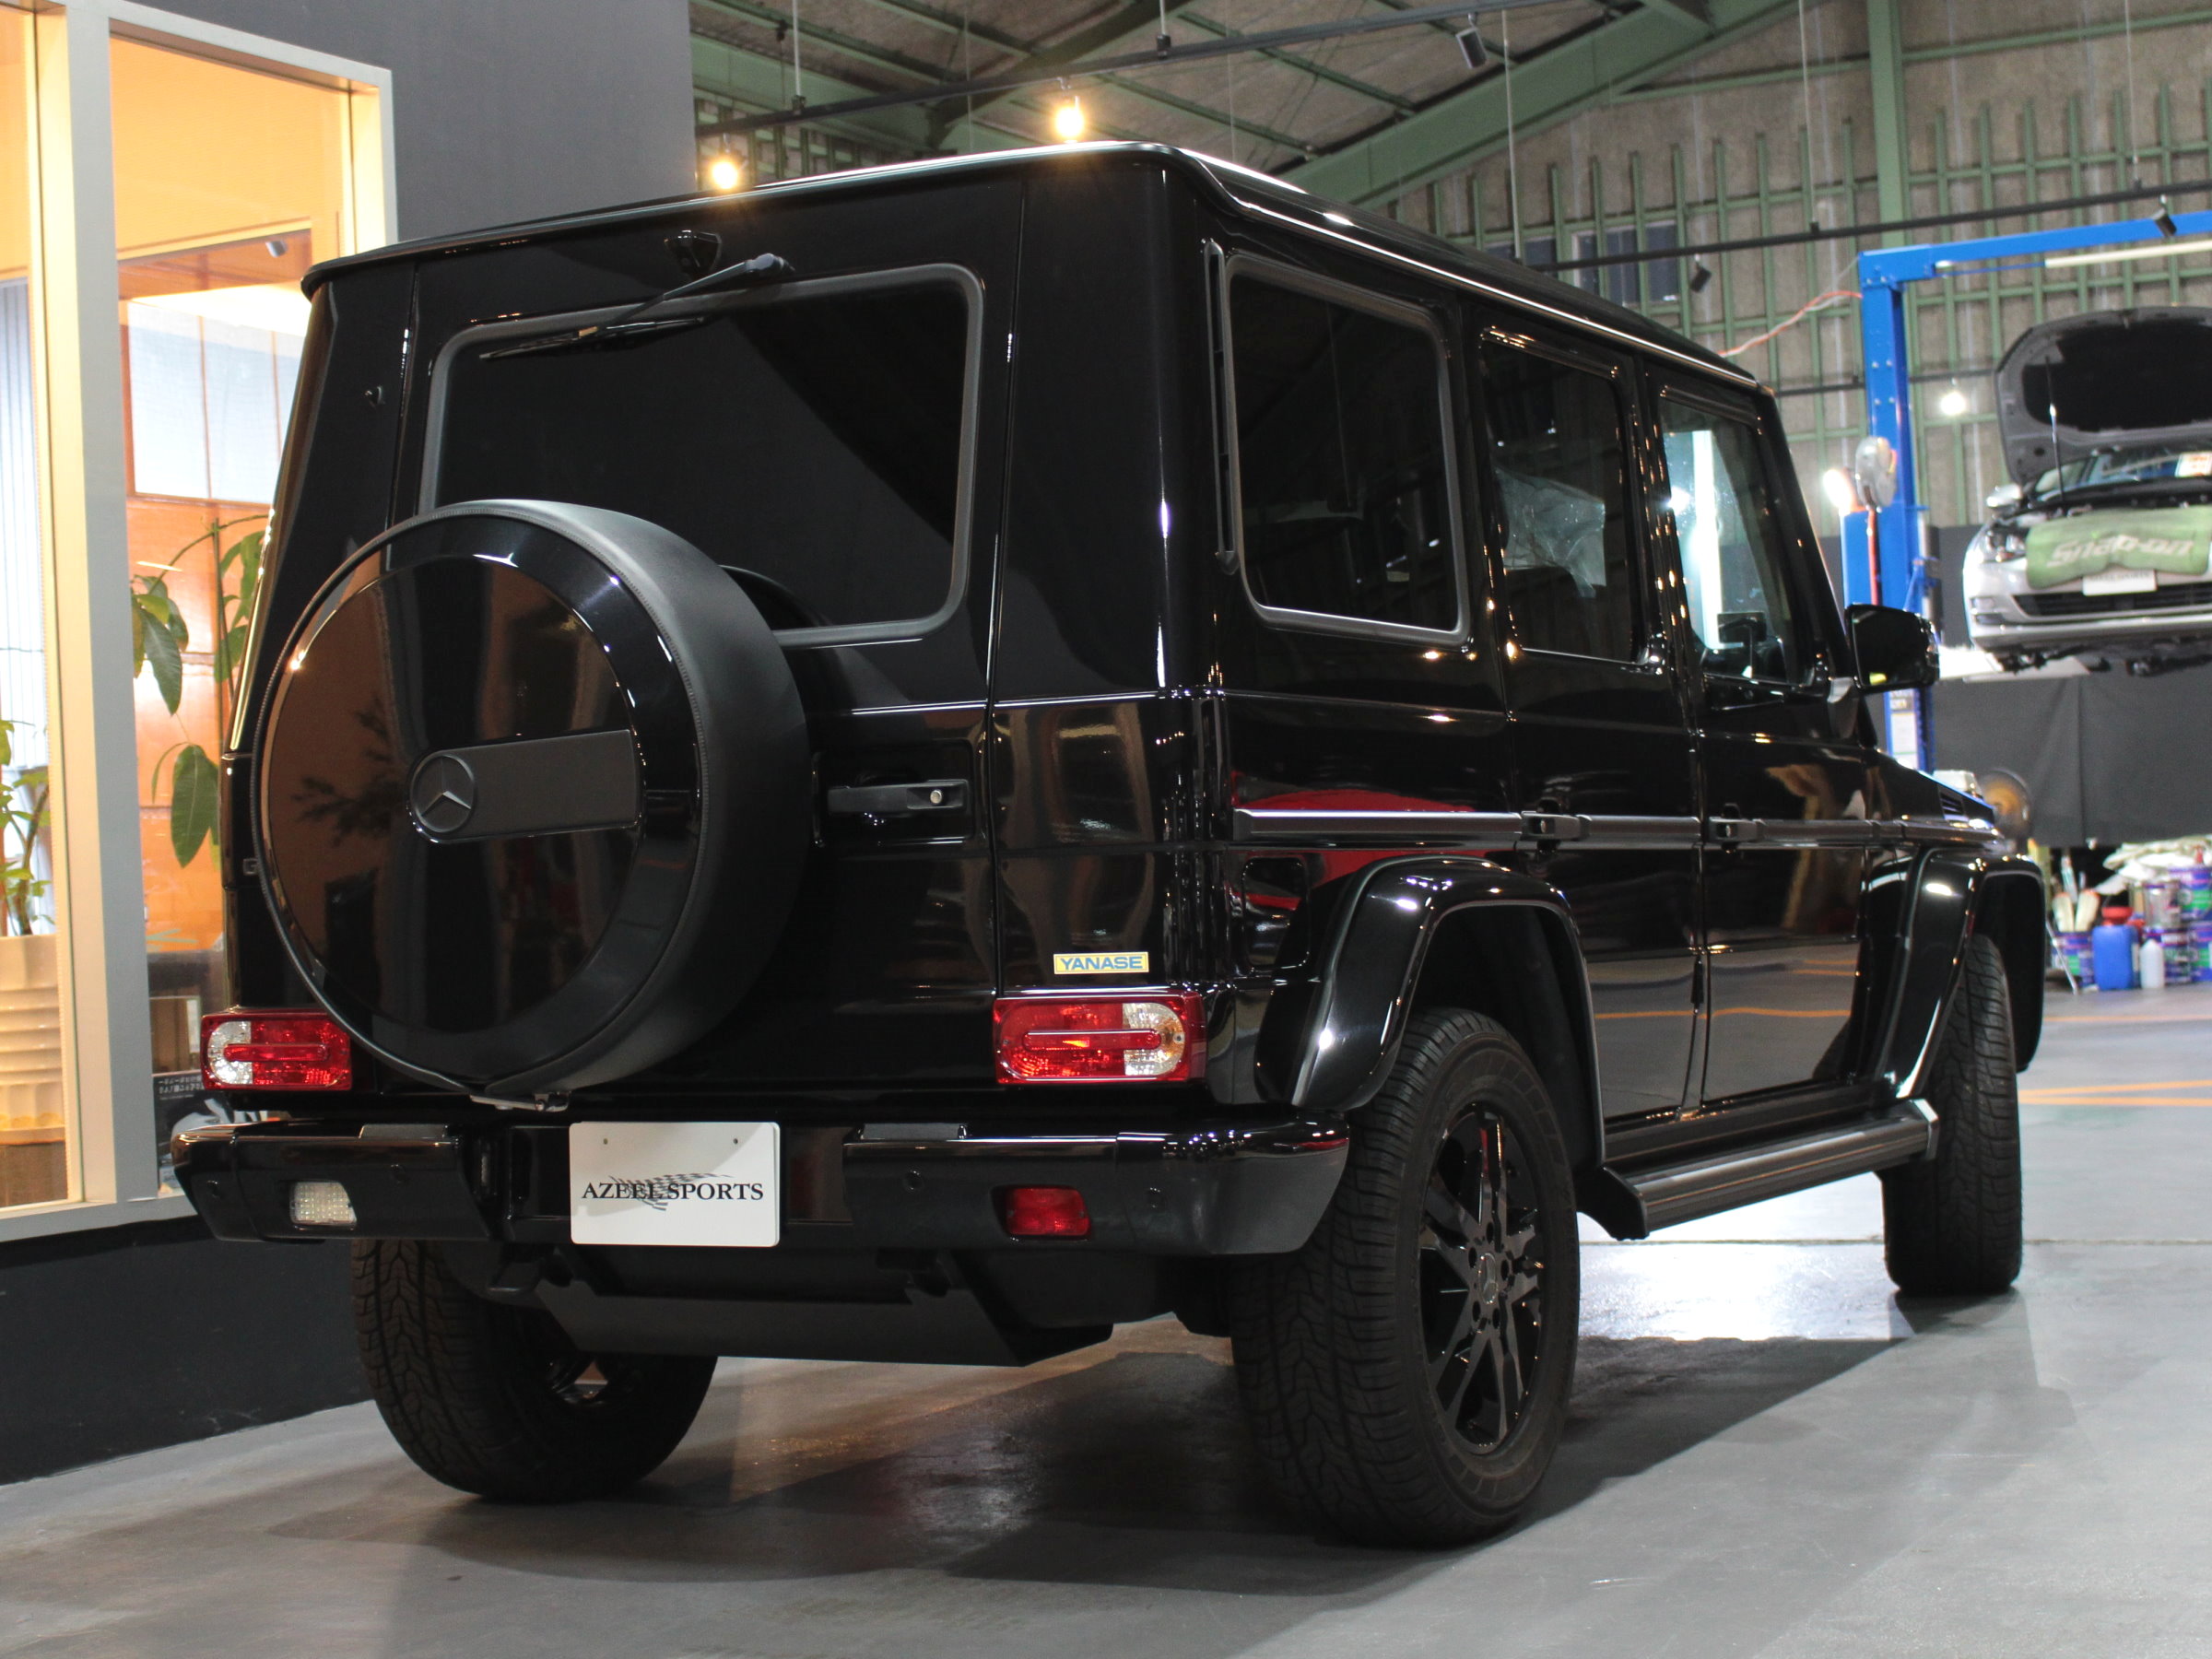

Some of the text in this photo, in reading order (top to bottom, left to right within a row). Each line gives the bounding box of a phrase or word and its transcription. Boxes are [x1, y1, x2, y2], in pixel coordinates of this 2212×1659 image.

[1060, 956, 1143, 971] YANASE
[582, 1182, 764, 1201] AZEEL SPORTS
